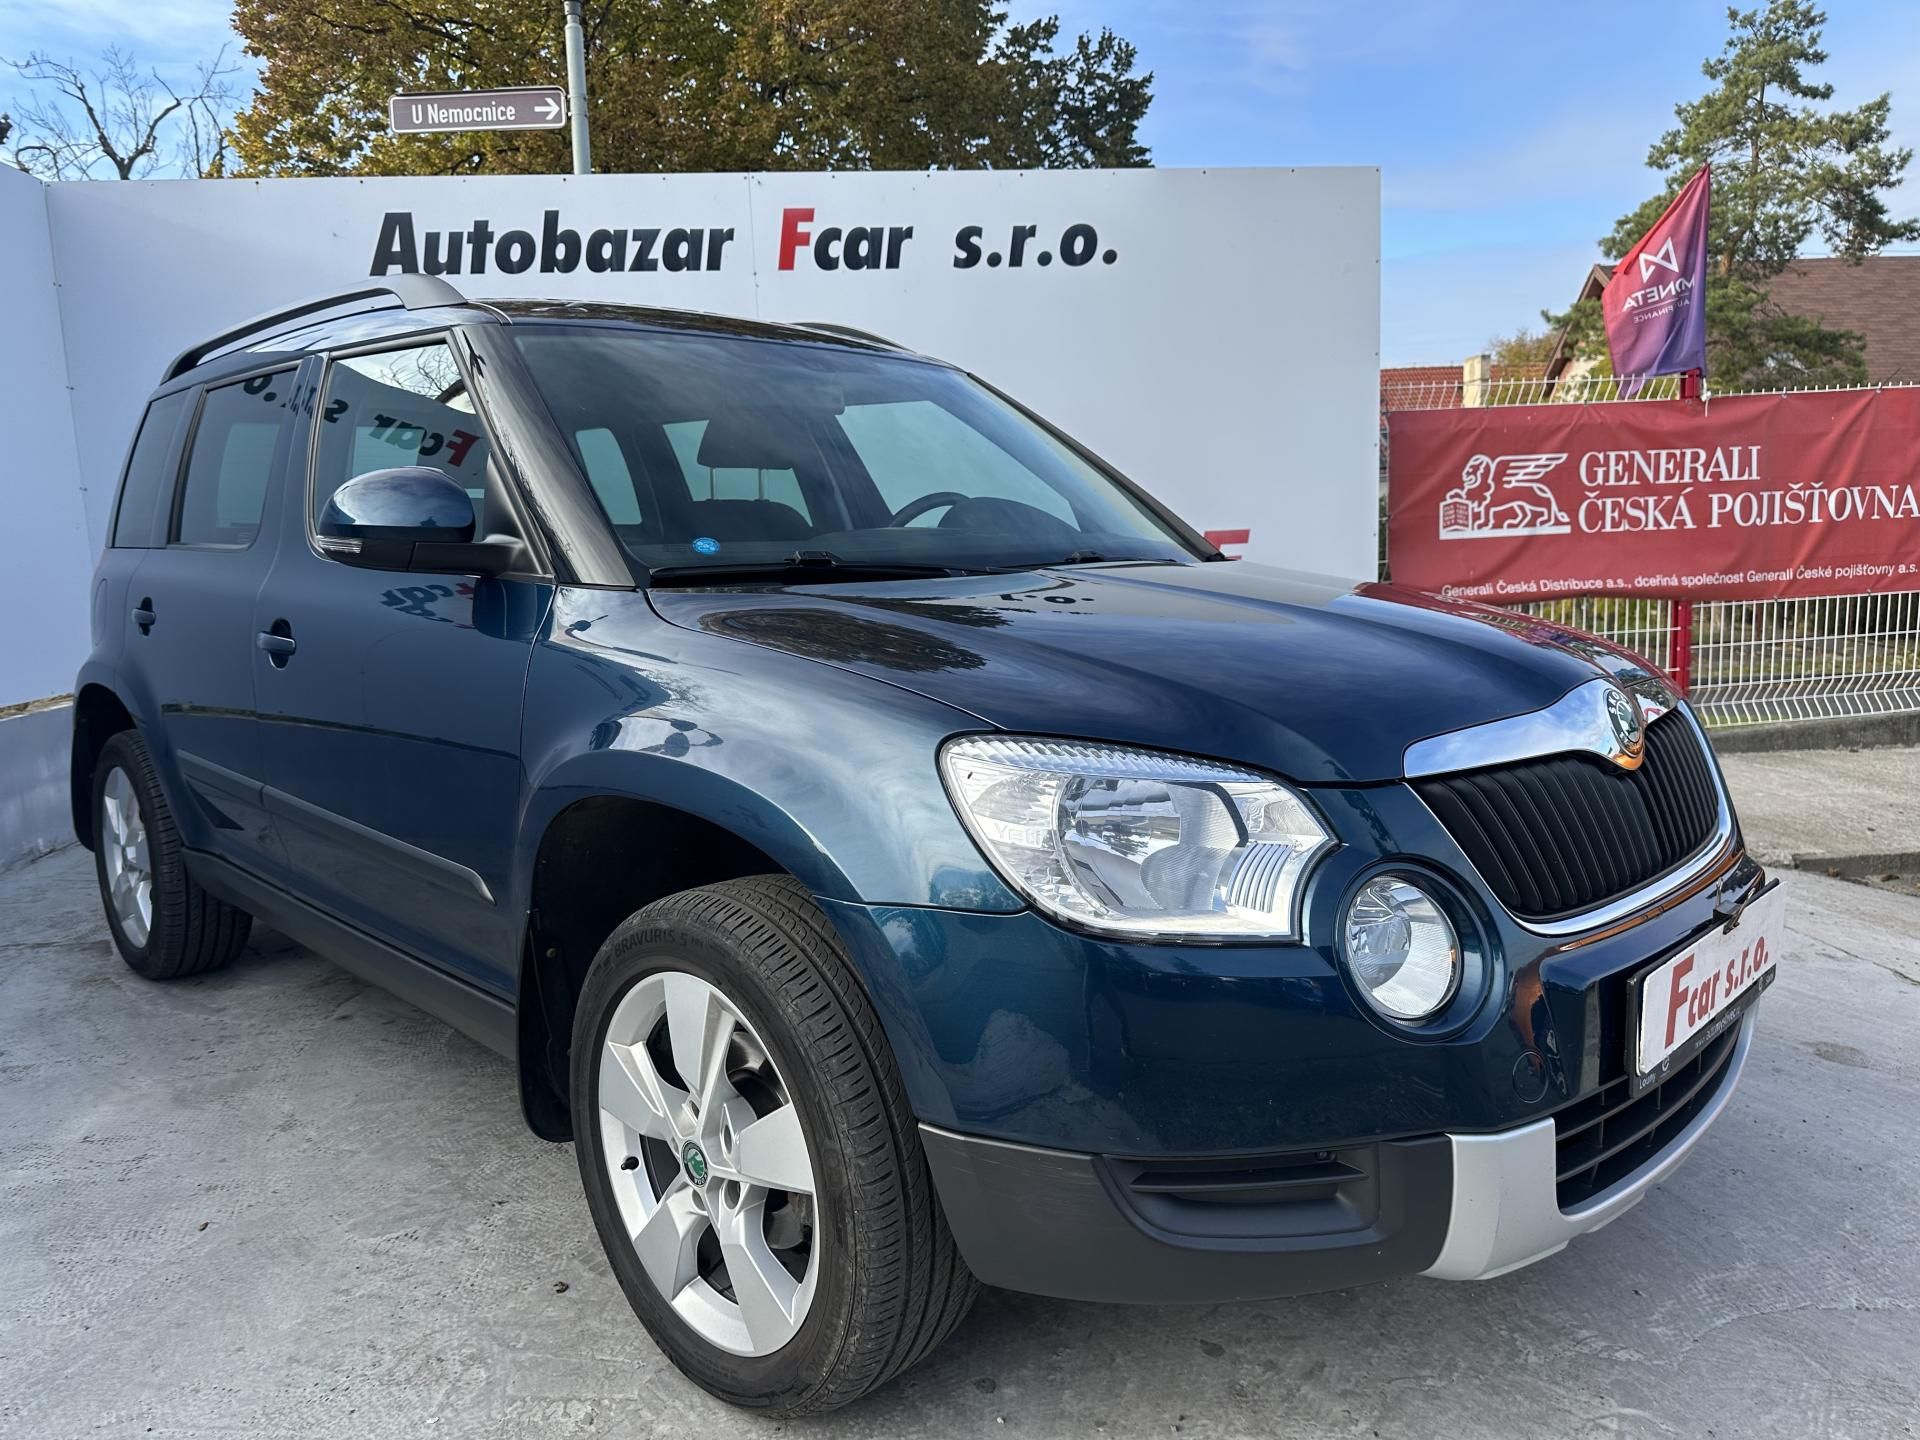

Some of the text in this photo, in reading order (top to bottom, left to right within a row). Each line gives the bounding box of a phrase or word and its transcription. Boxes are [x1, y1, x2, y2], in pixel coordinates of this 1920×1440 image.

[411, 101, 516, 124] U Nemocnice
[369, 207, 1118, 277] Autobazar Fcar s.r.o.
[1579, 446, 1761, 487] GENERALI
[1578, 481, 1920, 533] ČESKÁ POJIŠŤOVNA
[1441, 563, 1919, 597] Generali Česká Distribuce a.s., dceřiná společnost Generali České pojišťovny a.s.
[1664, 953, 1721, 1050] Fcar
[1724, 936, 1769, 998] s.r.o.
